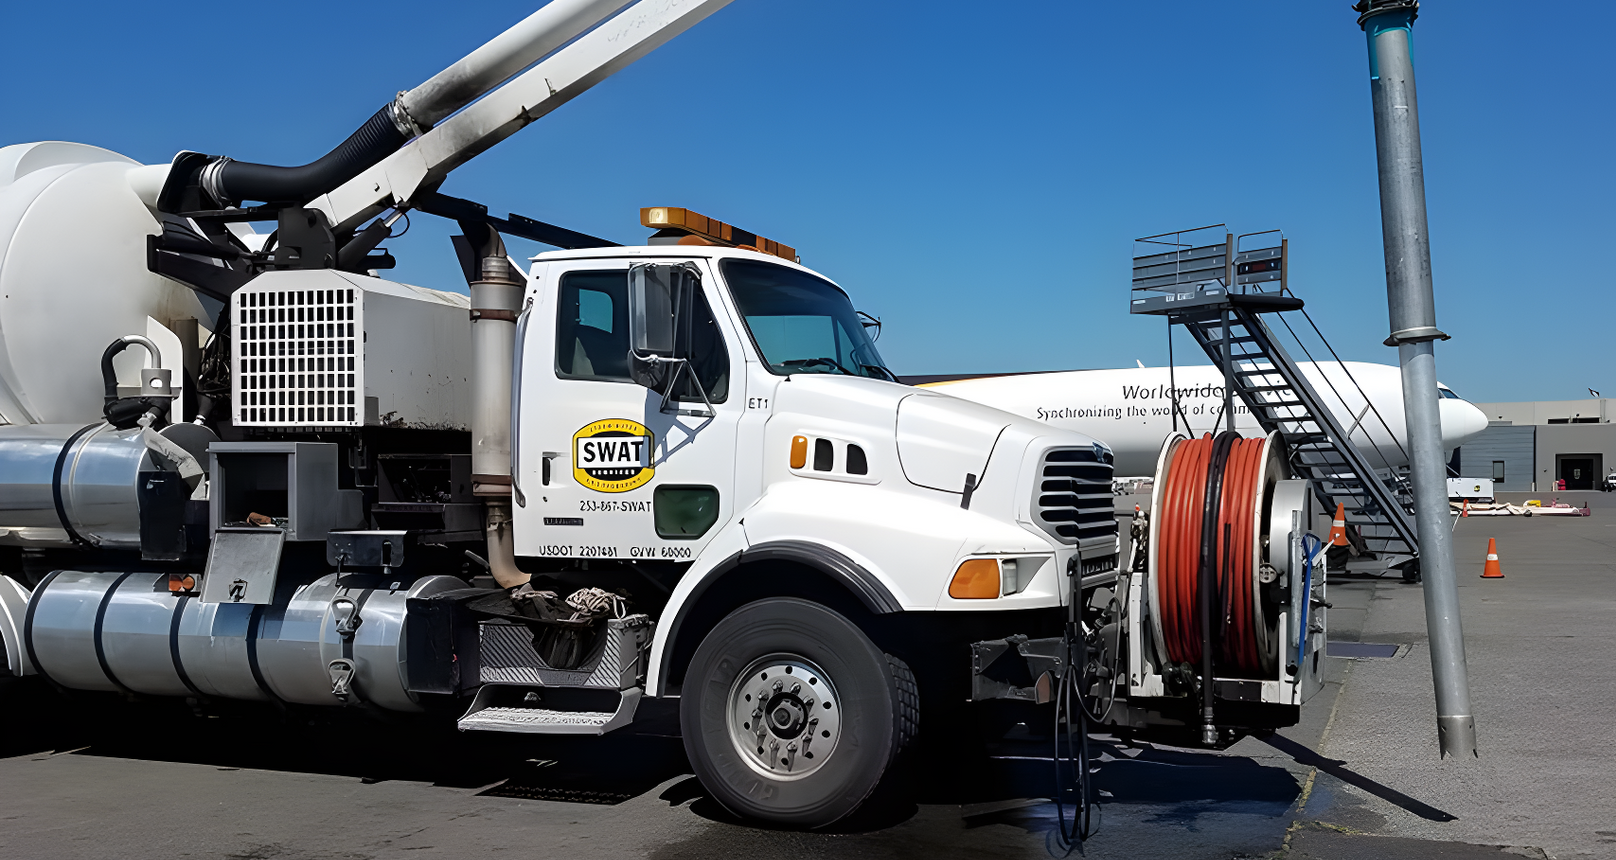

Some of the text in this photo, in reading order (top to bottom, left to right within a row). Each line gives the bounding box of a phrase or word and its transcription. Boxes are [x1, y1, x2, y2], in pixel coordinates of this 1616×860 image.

[1037, 406, 1122, 421] Synchronizing
[1127, 405, 1147, 417] the
[1193, 403, 1204, 415] of
[583, 441, 644, 463] SWAT
[539, 545, 573, 556] USDOT
